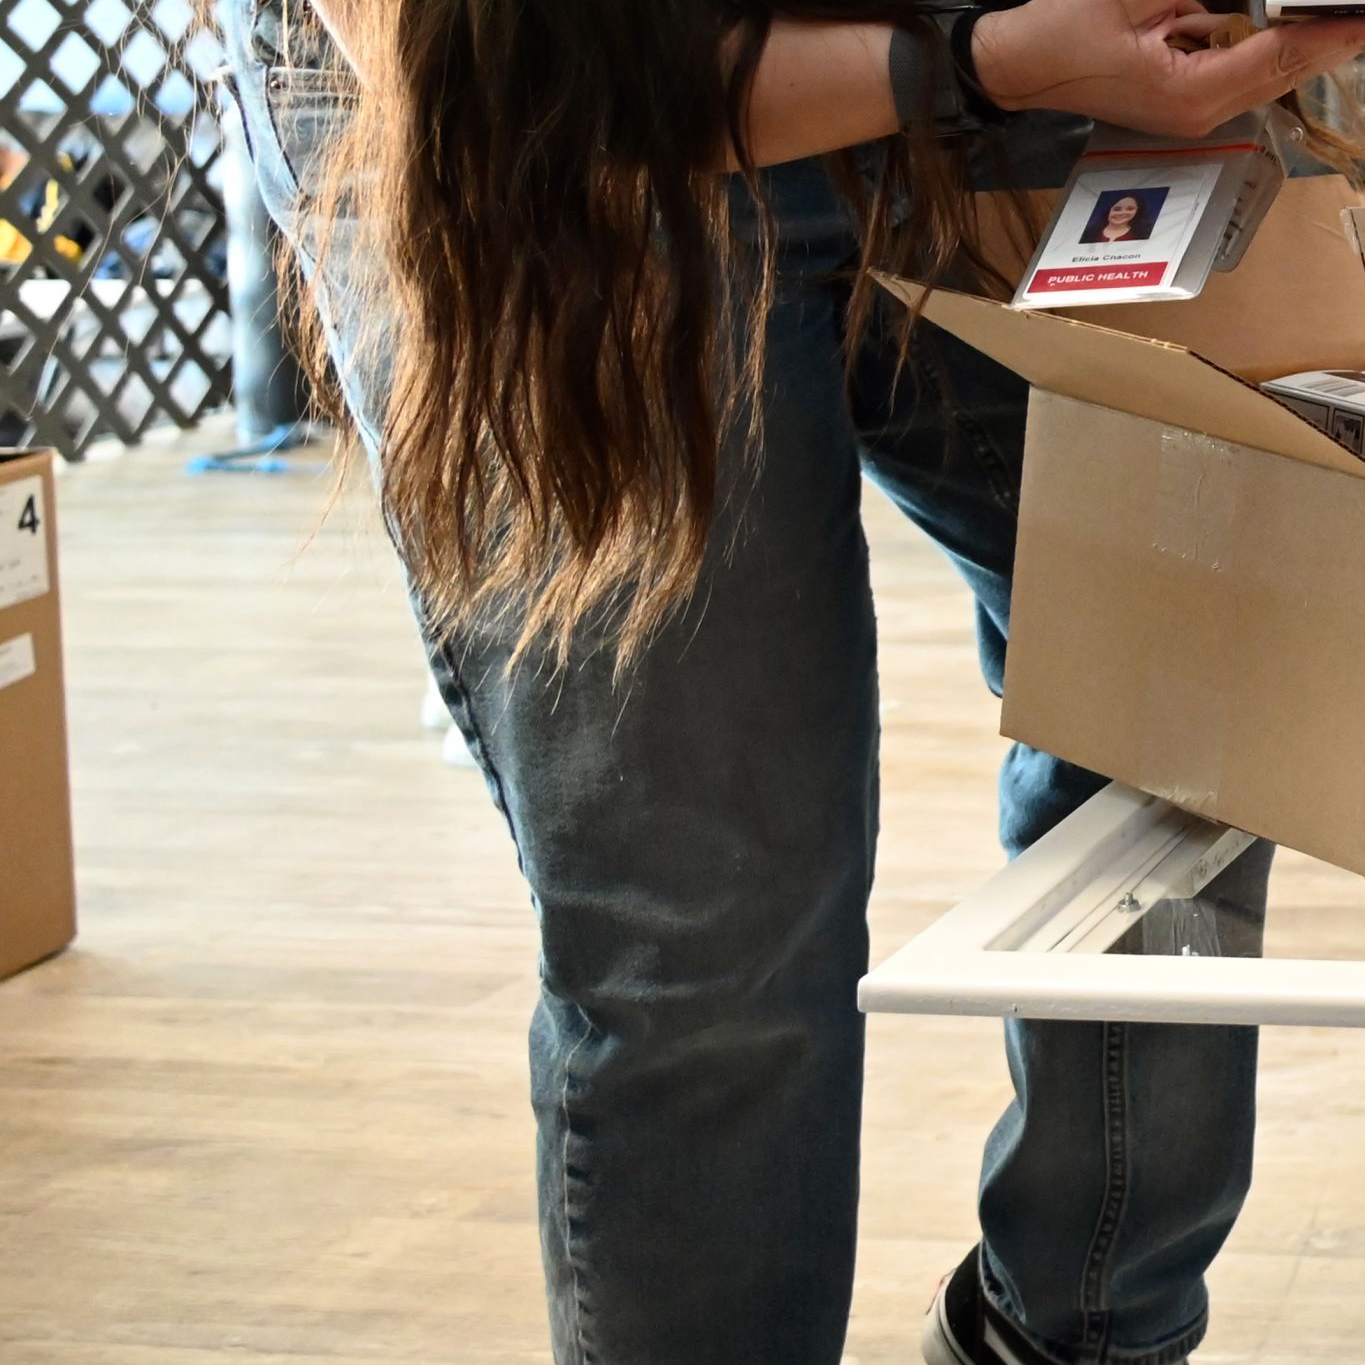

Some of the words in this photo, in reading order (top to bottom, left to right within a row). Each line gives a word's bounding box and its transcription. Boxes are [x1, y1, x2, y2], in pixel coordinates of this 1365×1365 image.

[1047, 273, 1094, 285] PUBLIC
[1097, 270, 1149, 282] HEALTH
[18, 494, 40, 535] 4
